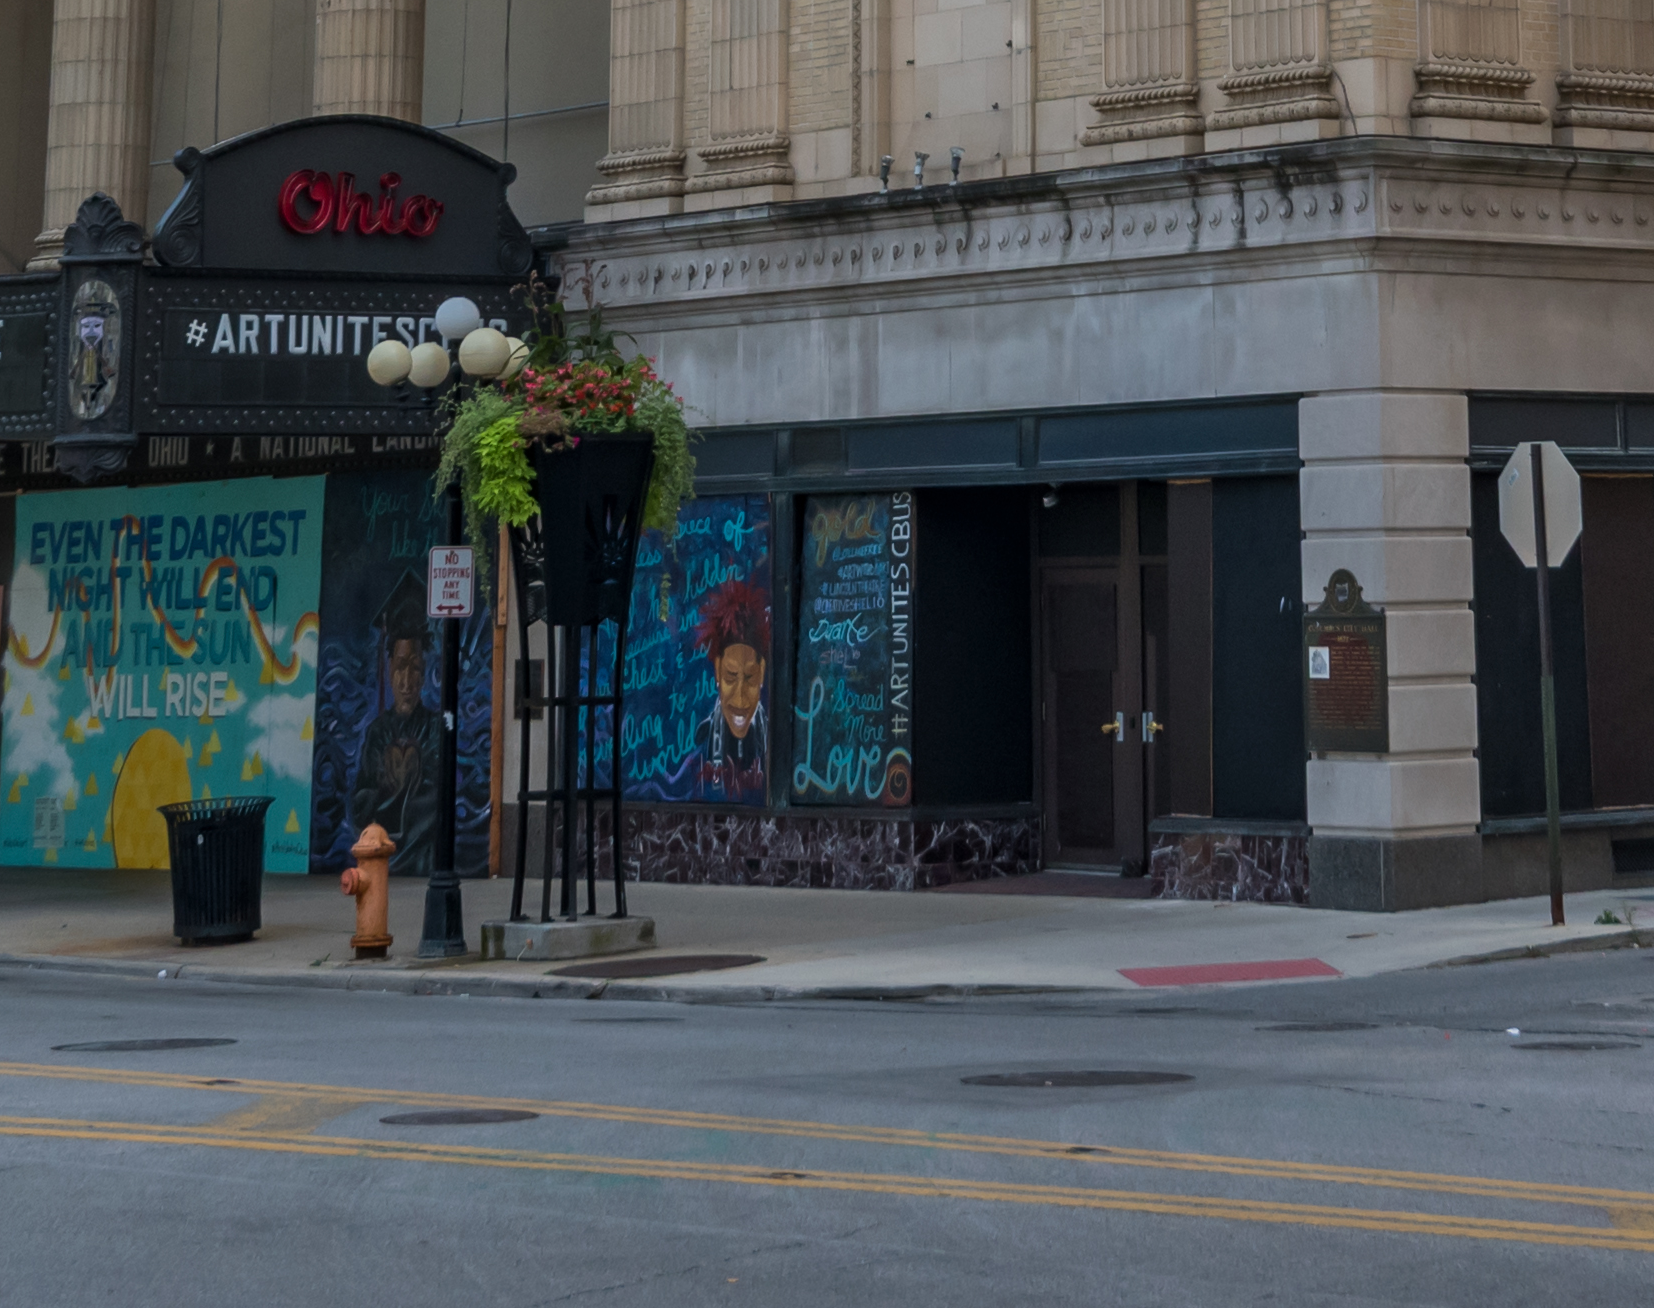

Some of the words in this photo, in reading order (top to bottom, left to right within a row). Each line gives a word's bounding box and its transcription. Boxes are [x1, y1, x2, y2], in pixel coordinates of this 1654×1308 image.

[278, 168, 443, 238] Ohio
[30, 519, 104, 565] EVEN
[110, 515, 164, 561] THE
[169, 509, 306, 561] DARKEST
[723, 511, 755, 552] of
[433, 568, 471, 579] STOPPING
[445, 555, 459, 565] NO
[683, 553, 745, 604] hidden
[48, 565, 132, 612] NIGHT
[139, 566, 209, 611] WILL
[215, 565, 276, 612] END
[442, 591, 460, 600] TIME
[444, 581, 459, 589] ANY
[60, 618, 124, 668] AND
[130, 619, 186, 666] THE
[192, 618, 251, 666] SUN
[86, 672, 158, 721] WILL
[165, 670, 227, 718] RISE
[628, 710, 696, 781] world
